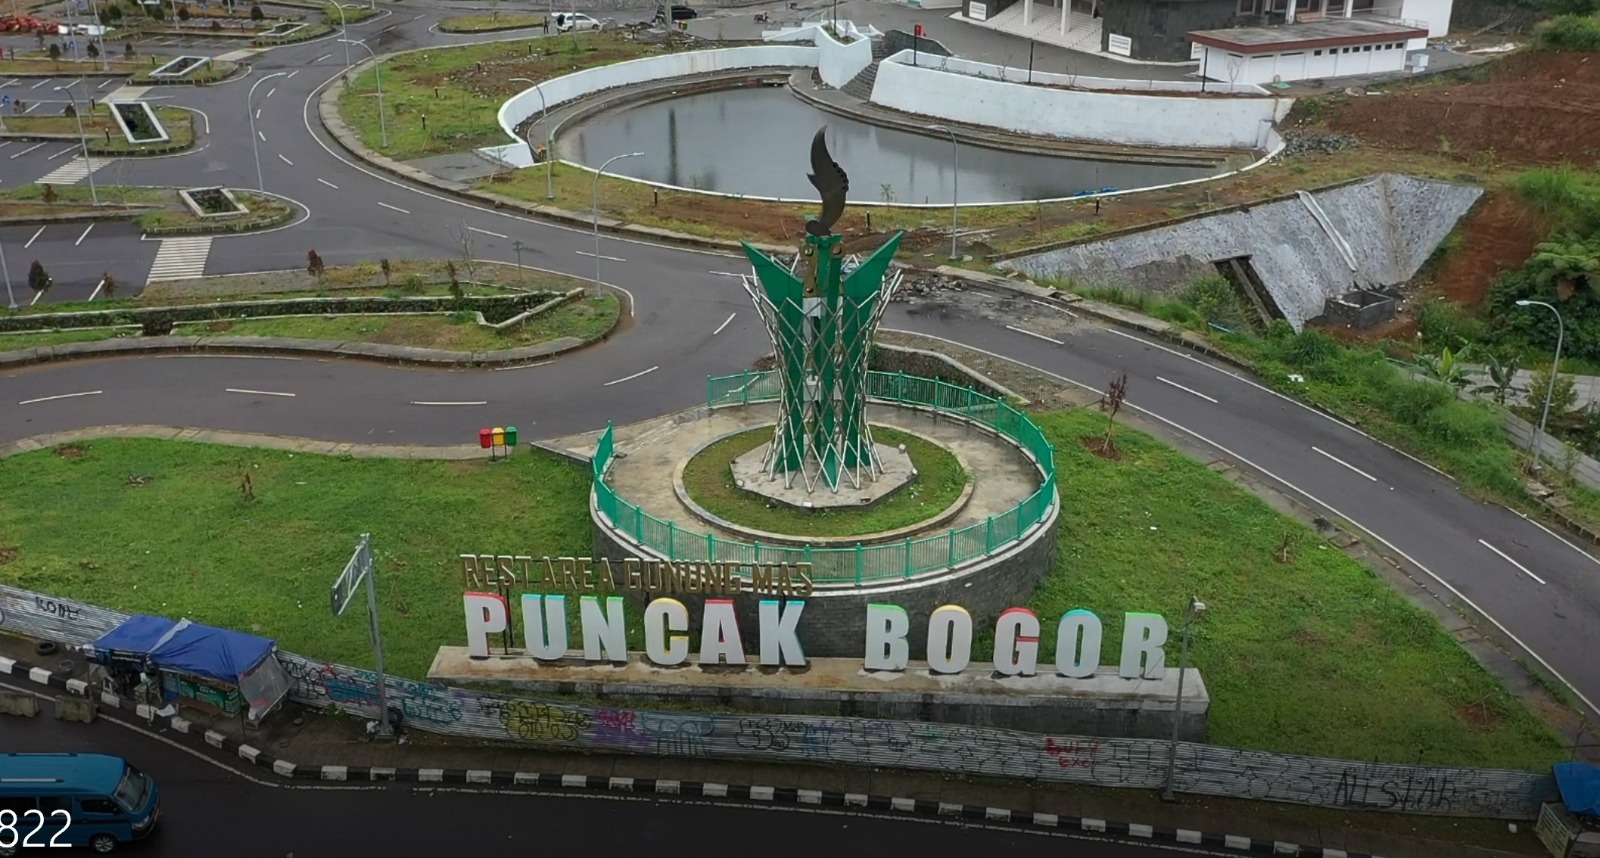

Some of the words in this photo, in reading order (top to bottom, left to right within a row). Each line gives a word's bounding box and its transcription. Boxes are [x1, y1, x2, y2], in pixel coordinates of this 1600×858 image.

[460, 554, 532, 588] REST
[542, 556, 615, 590] AREA
[624, 558, 742, 595] GUNUNG
[752, 560, 813, 597] MAS
[463, 591, 811, 666] PUNCAK
[864, 603, 1168, 679] BOGOR
